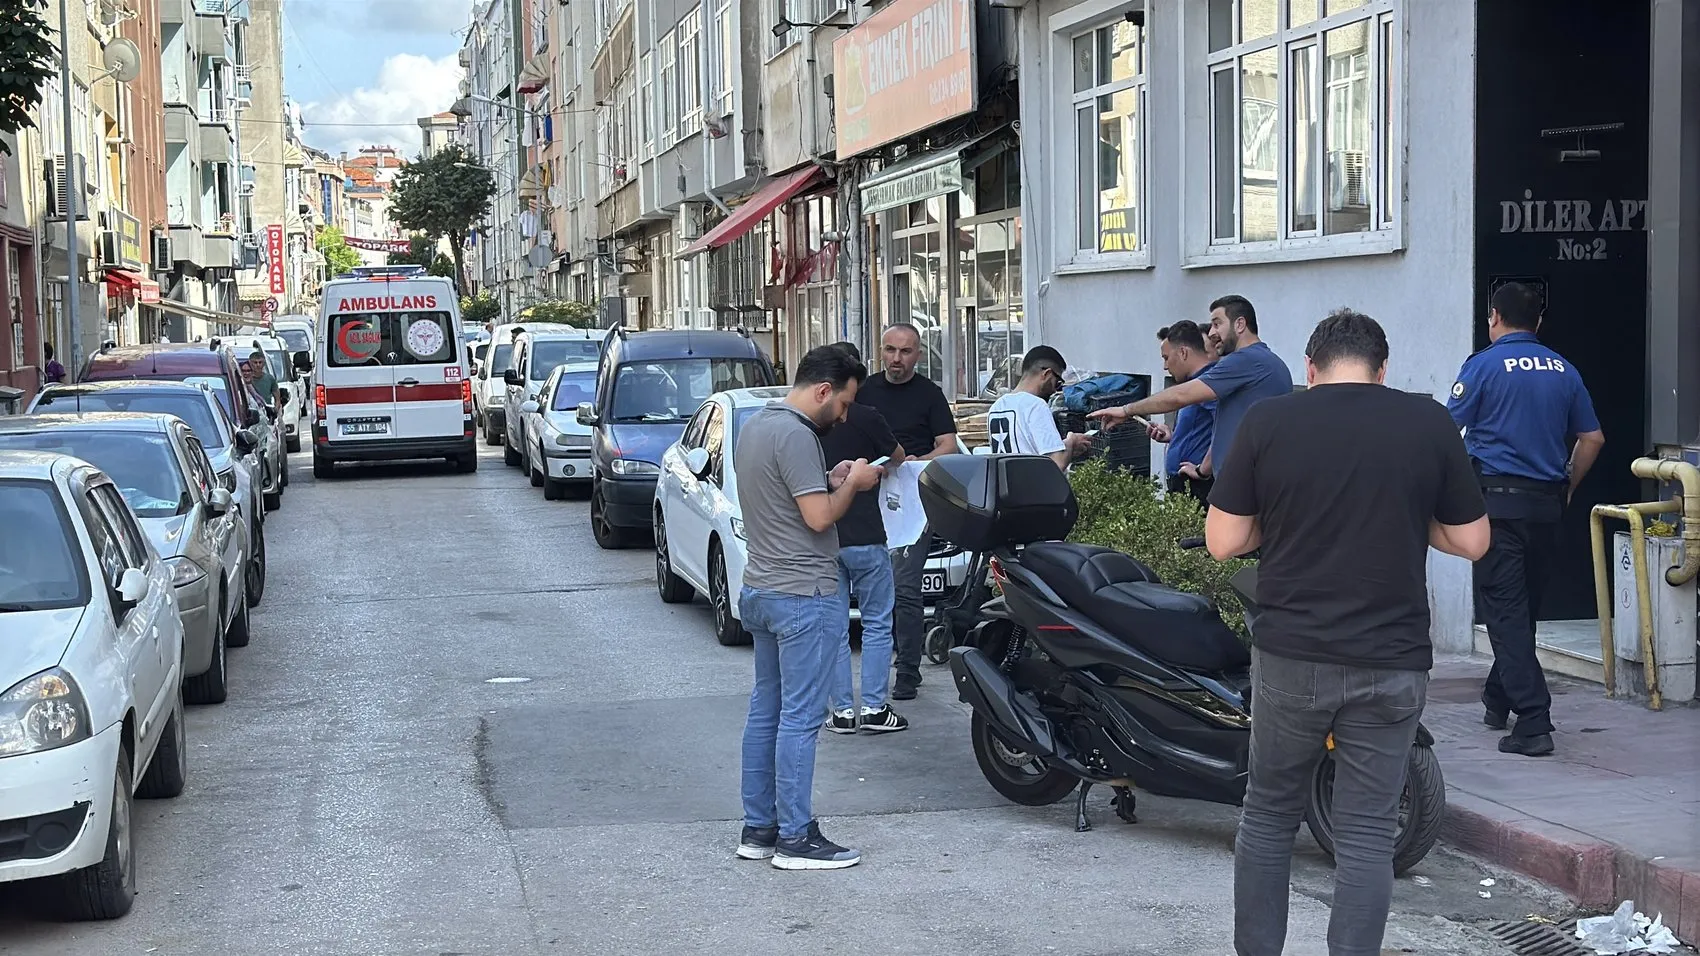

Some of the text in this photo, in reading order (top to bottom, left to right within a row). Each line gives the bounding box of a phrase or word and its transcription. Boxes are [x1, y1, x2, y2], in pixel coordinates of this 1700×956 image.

[868, 21, 909, 96] EKMEK
[1500, 188, 1594, 233] DİLER
[1556, 238, 1608, 260] No:2
[271, 231, 282, 291] OTOPARK
[338, 295, 437, 311] AMBULANS
[446, 368, 459, 376] 112
[346, 424, 355, 432] 55
[923, 575, 942, 590] 90
